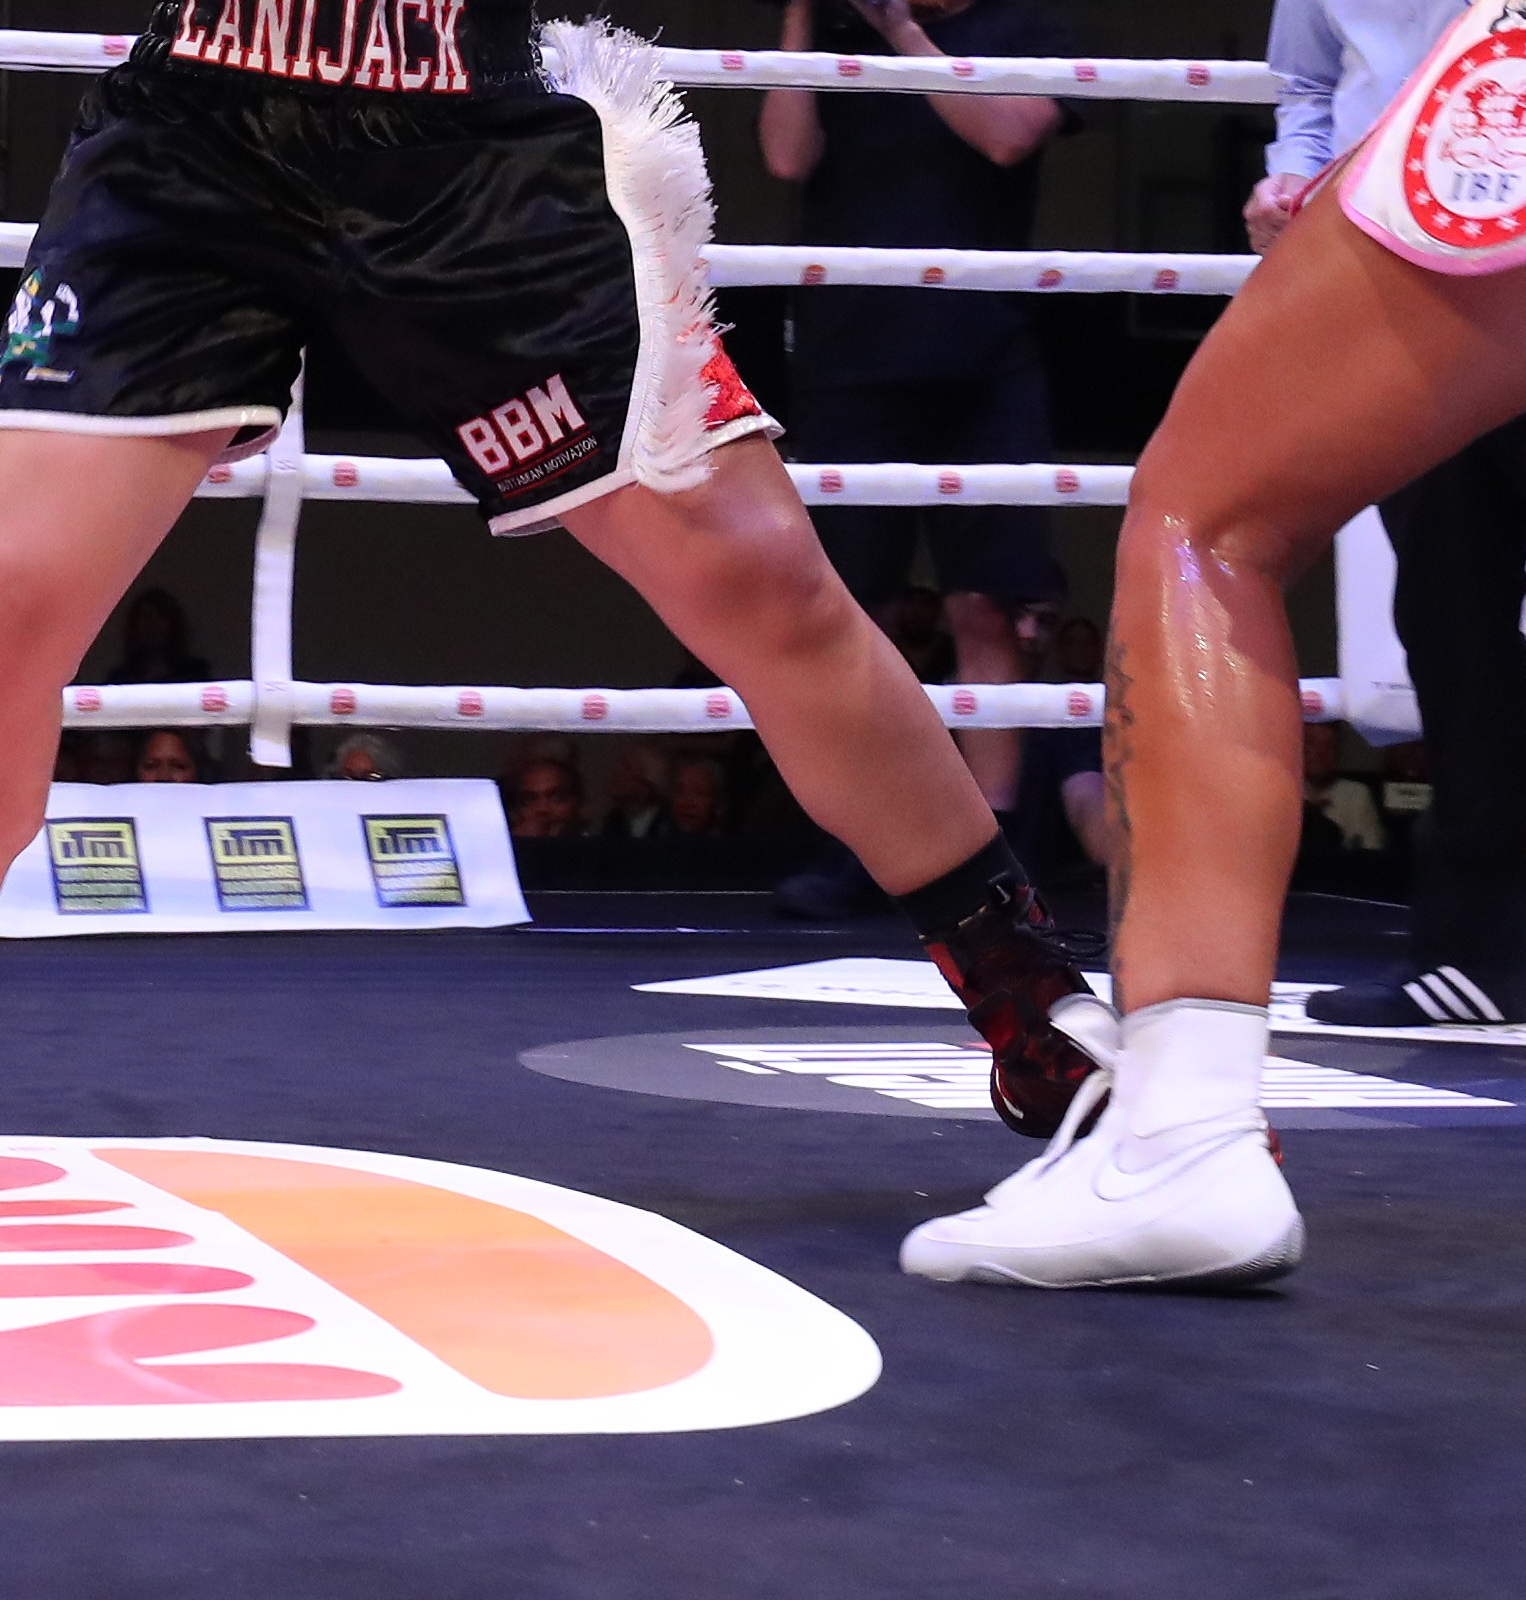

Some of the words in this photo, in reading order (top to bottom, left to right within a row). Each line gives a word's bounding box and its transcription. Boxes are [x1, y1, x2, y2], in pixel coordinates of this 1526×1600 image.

[1450, 172, 1520, 203] IBF
[457, 373, 585, 475] BBM
[543, 436, 599, 476] MOTIVATION
